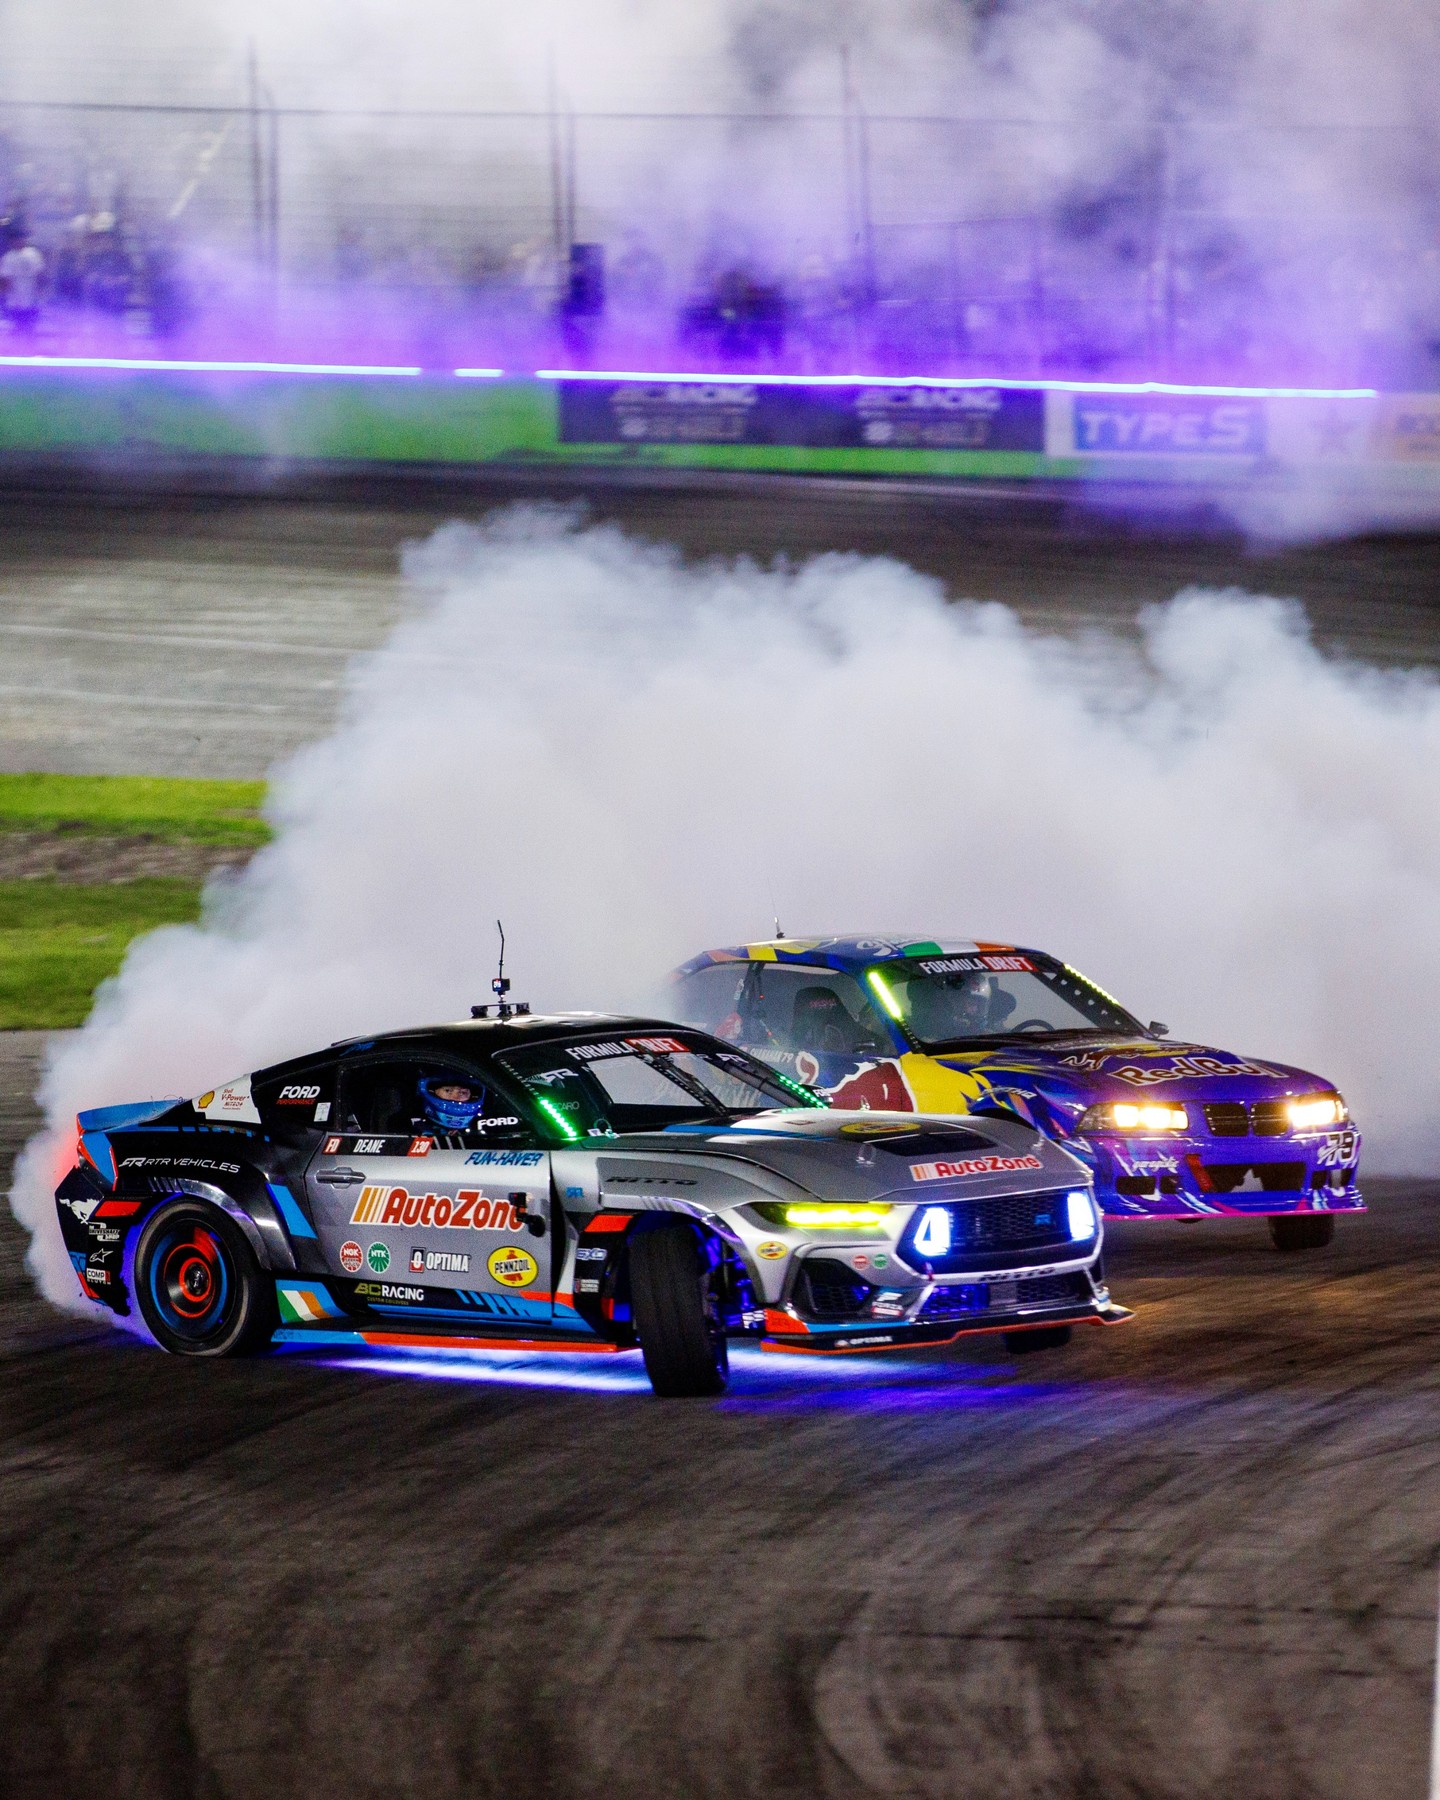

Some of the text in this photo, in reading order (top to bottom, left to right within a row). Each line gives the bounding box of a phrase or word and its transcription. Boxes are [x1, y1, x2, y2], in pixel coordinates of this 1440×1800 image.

[919, 956, 1034, 974] FORMULA DRIFT
[565, 1038, 685, 1060] FORMULA DRIFT
[221, 1093, 247, 1102] V-Power
[278, 1086, 320, 1099] FORD
[477, 1116, 519, 1130] FORD
[324, 1138, 430, 1154] FD DEANE 130
[144, 1158, 171, 1166] RTR
[173, 1158, 241, 1173] VEHICLES
[464, 1152, 544, 1167] FUN-HAVER
[934, 1156, 1041, 1177] AutoZone
[605, 1176, 697, 1185] NITTO
[371, 1250, 386, 1258] NTK
[426, 1252, 470, 1272] OPTIMA
[494, 1258, 531, 1274] PENNZOIL
[88, 1270, 104, 1279] COMP
[977, 1266, 1055, 1282] NITTO
